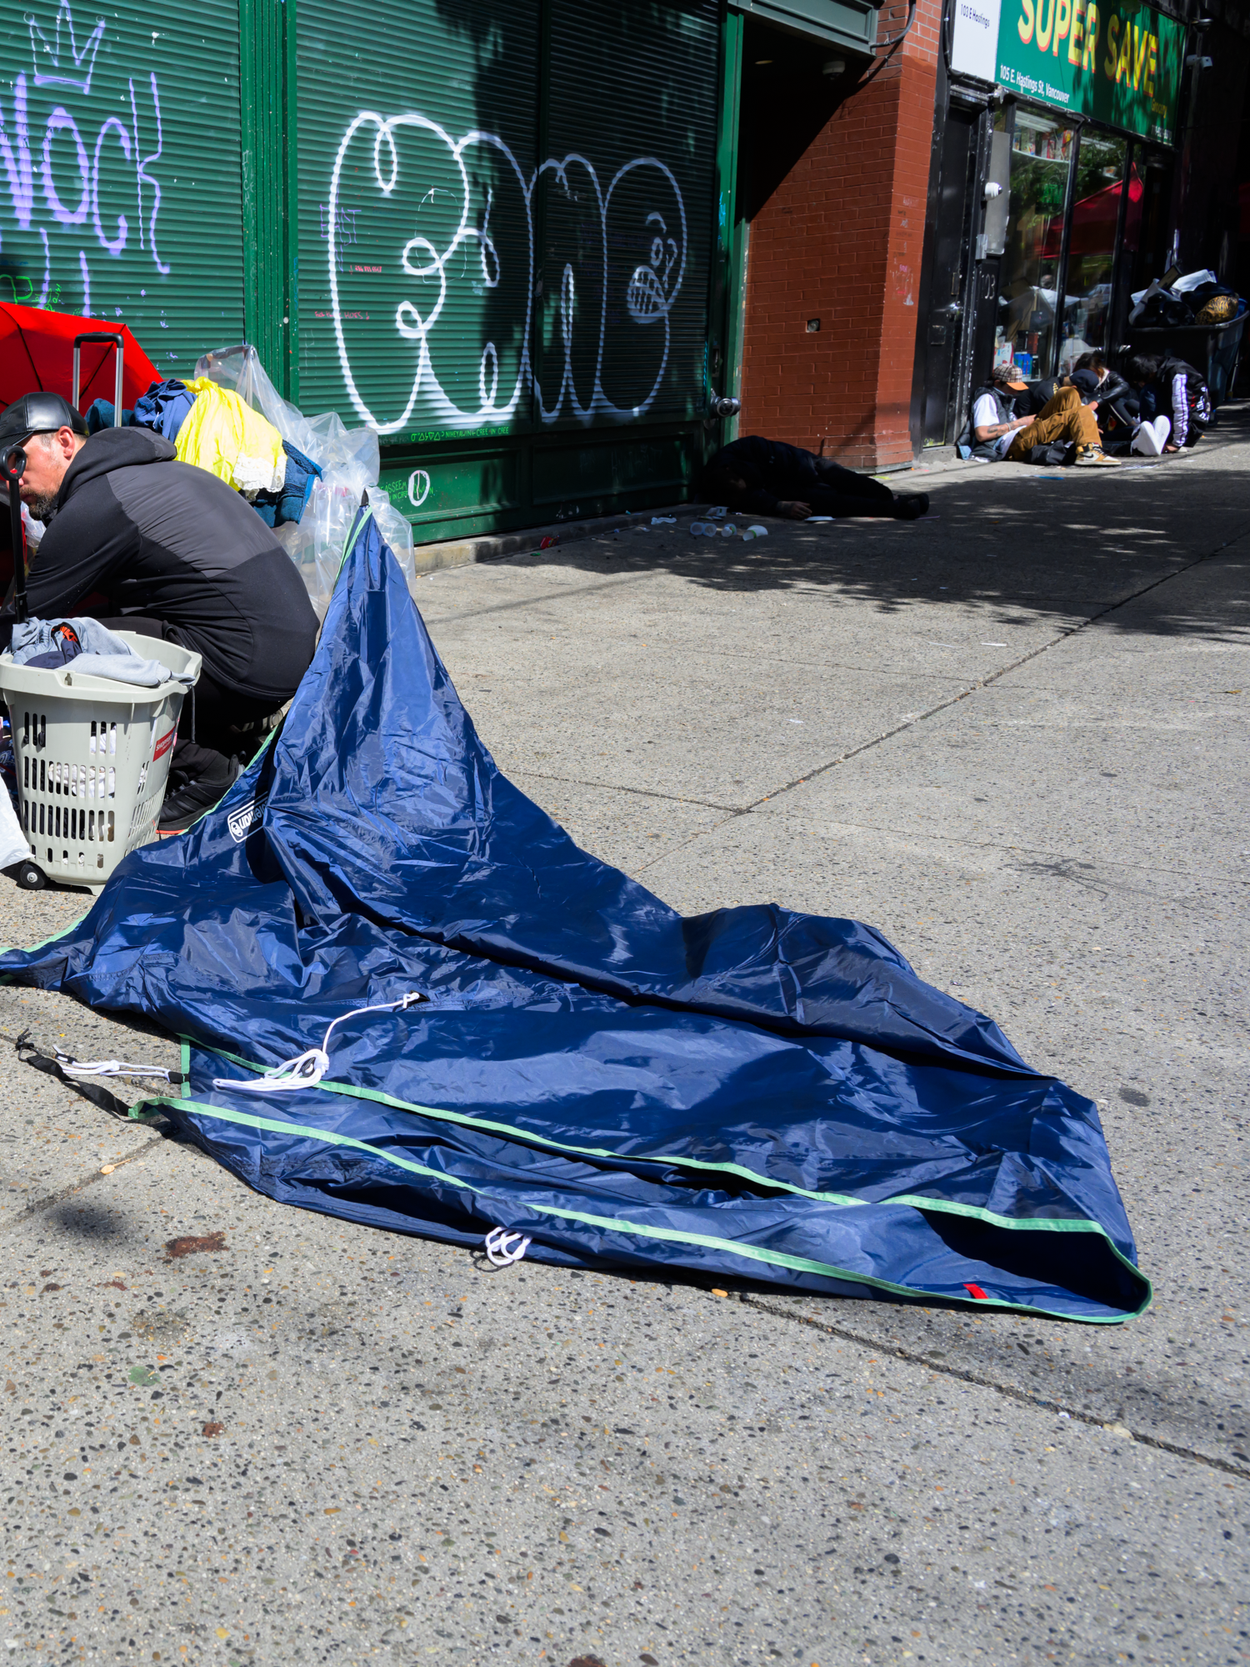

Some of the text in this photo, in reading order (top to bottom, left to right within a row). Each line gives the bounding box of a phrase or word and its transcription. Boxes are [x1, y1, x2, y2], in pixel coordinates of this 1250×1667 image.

[961, 3, 990, 29] 103 E Hastings
[1017, 0, 1158, 97] SUPER SAVE
[1000, 64, 1010, 81] 105
[1016, 71, 1038, 94] Hastings
[1046, 83, 1070, 103] Vancouver
